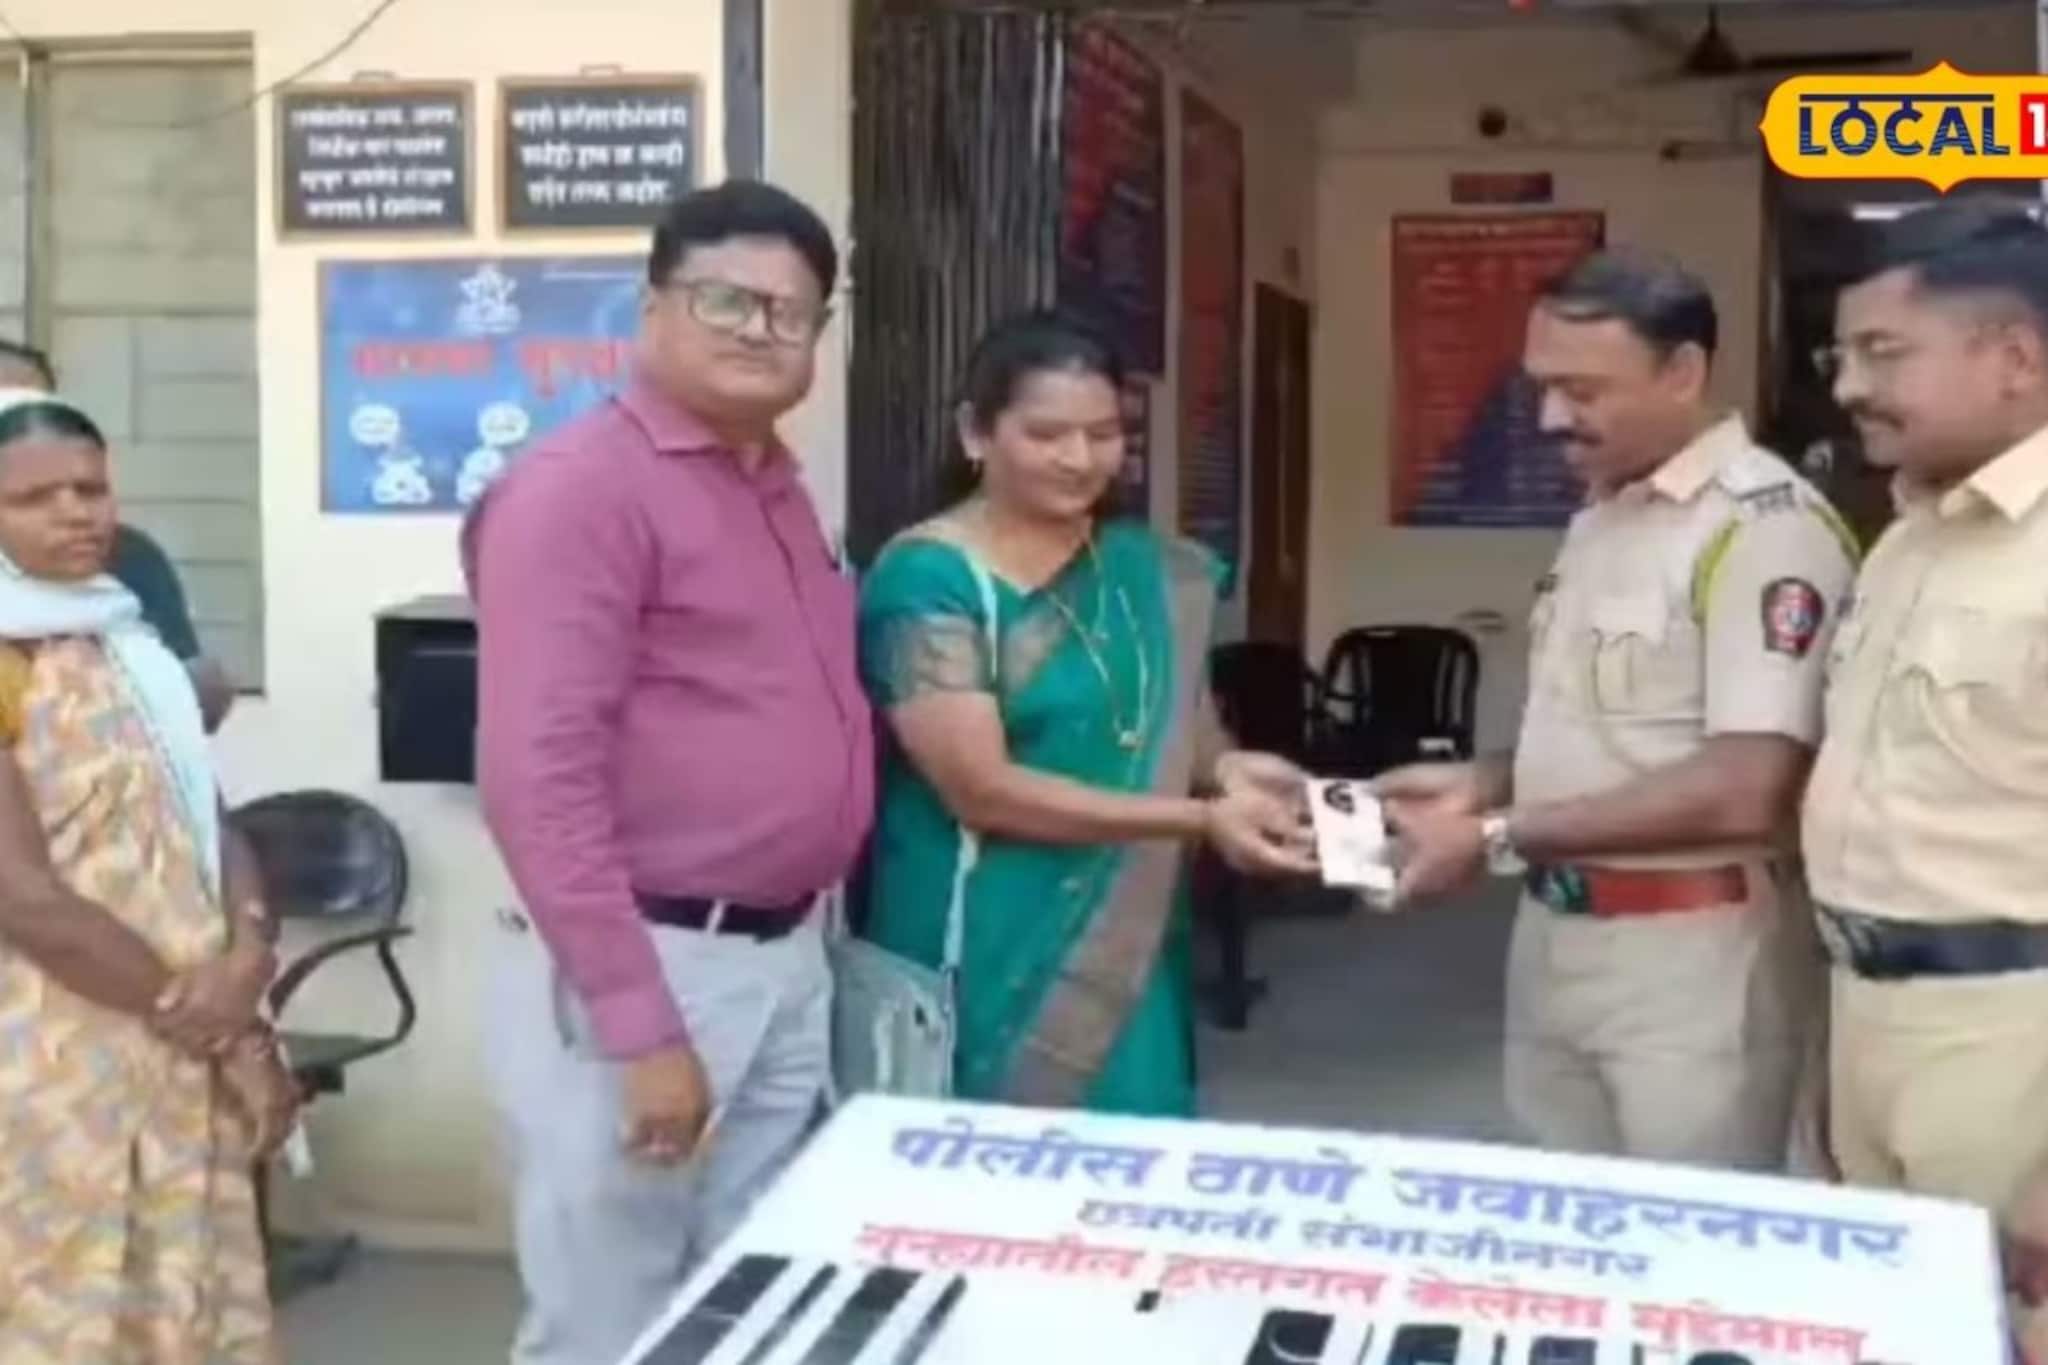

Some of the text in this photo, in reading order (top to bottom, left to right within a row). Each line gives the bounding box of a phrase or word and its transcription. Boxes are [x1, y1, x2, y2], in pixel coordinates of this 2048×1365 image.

[892, 1116, 1909, 1266] पोलीस ठाणे जवाहरनगर
